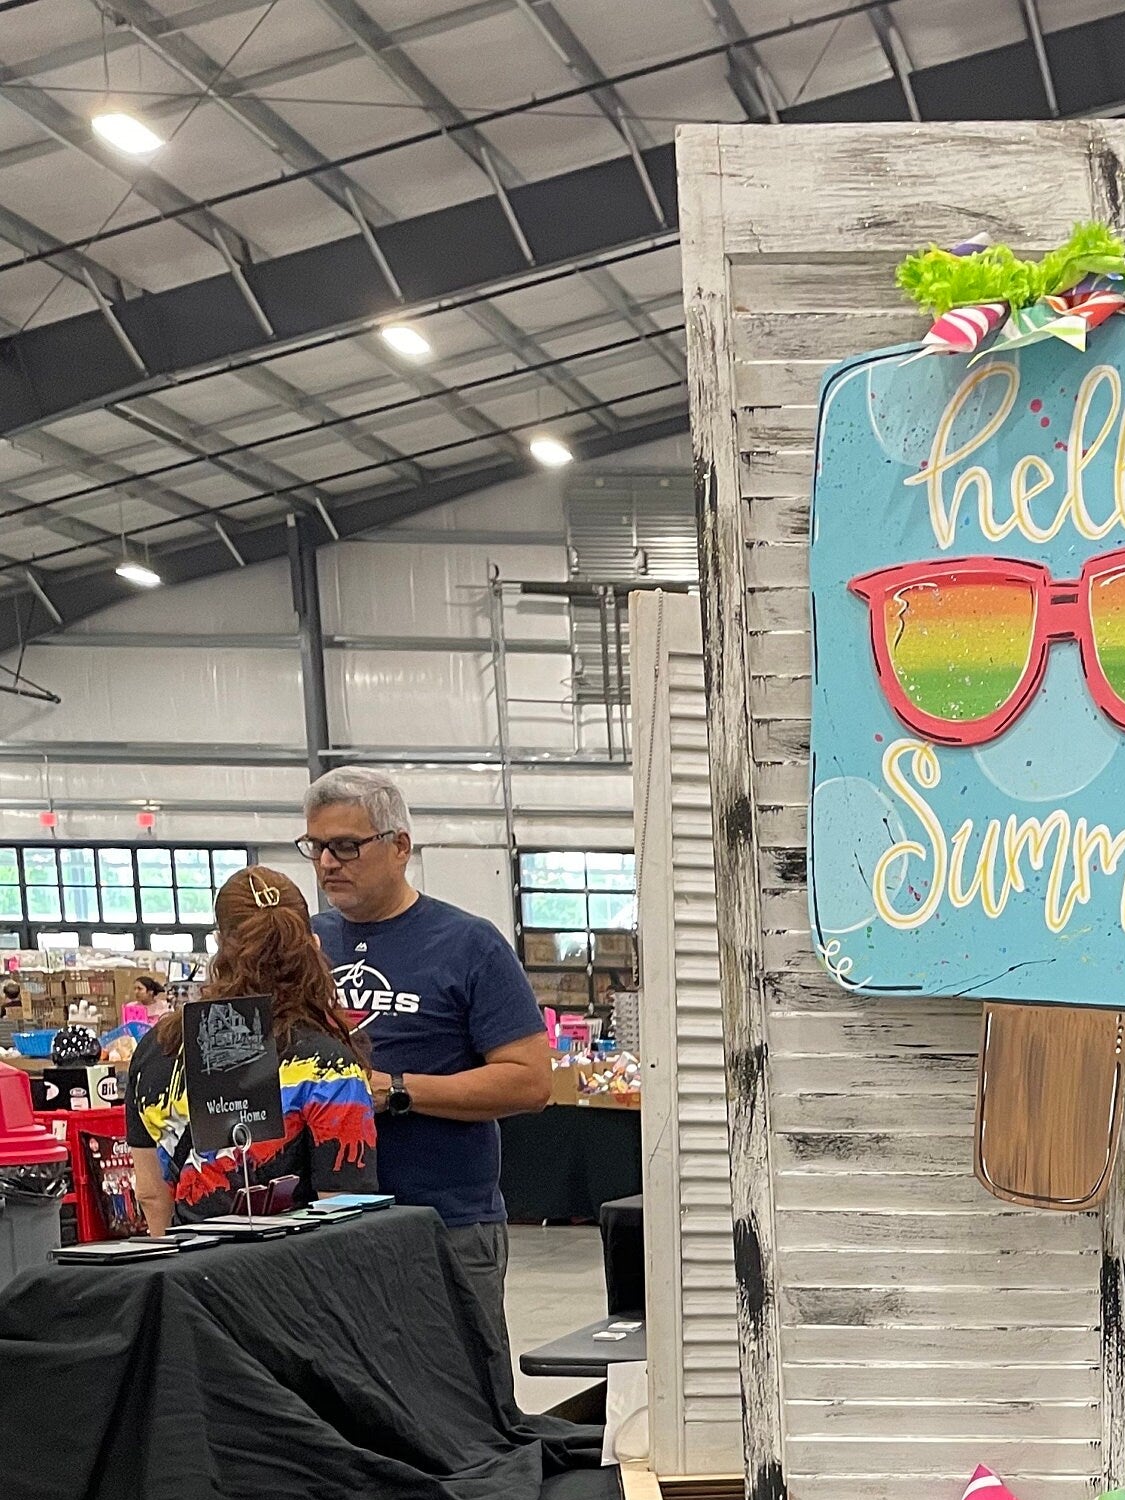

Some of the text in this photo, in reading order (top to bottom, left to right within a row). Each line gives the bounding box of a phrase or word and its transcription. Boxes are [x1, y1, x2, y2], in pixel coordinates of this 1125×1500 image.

[328, 988, 420, 1013] AVES
[206, 1096, 249, 1114] Welcome
[240, 1110, 267, 1123] Home
